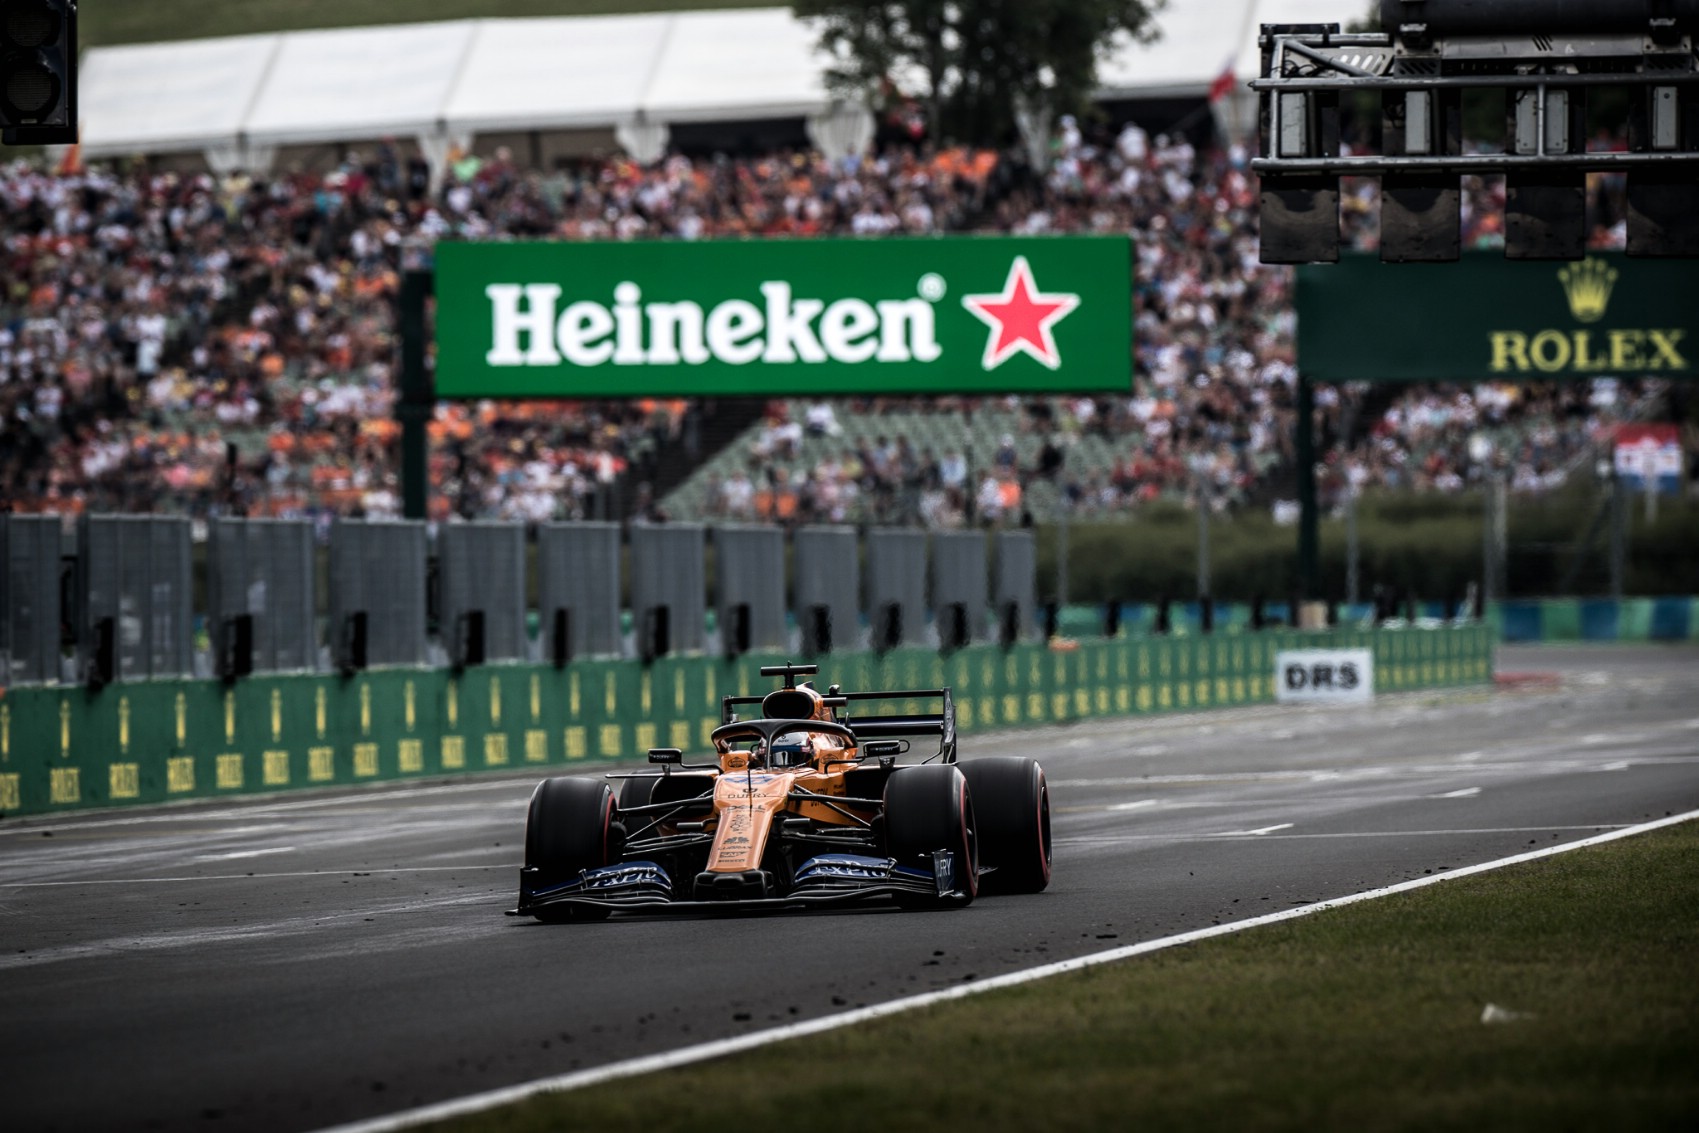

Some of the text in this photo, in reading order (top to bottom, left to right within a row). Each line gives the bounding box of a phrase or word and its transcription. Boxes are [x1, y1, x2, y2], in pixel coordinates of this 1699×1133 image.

[485, 280, 942, 367] Heineken
[1489, 328, 1687, 373] ROLEX
[1284, 662, 1360, 690] DRS
